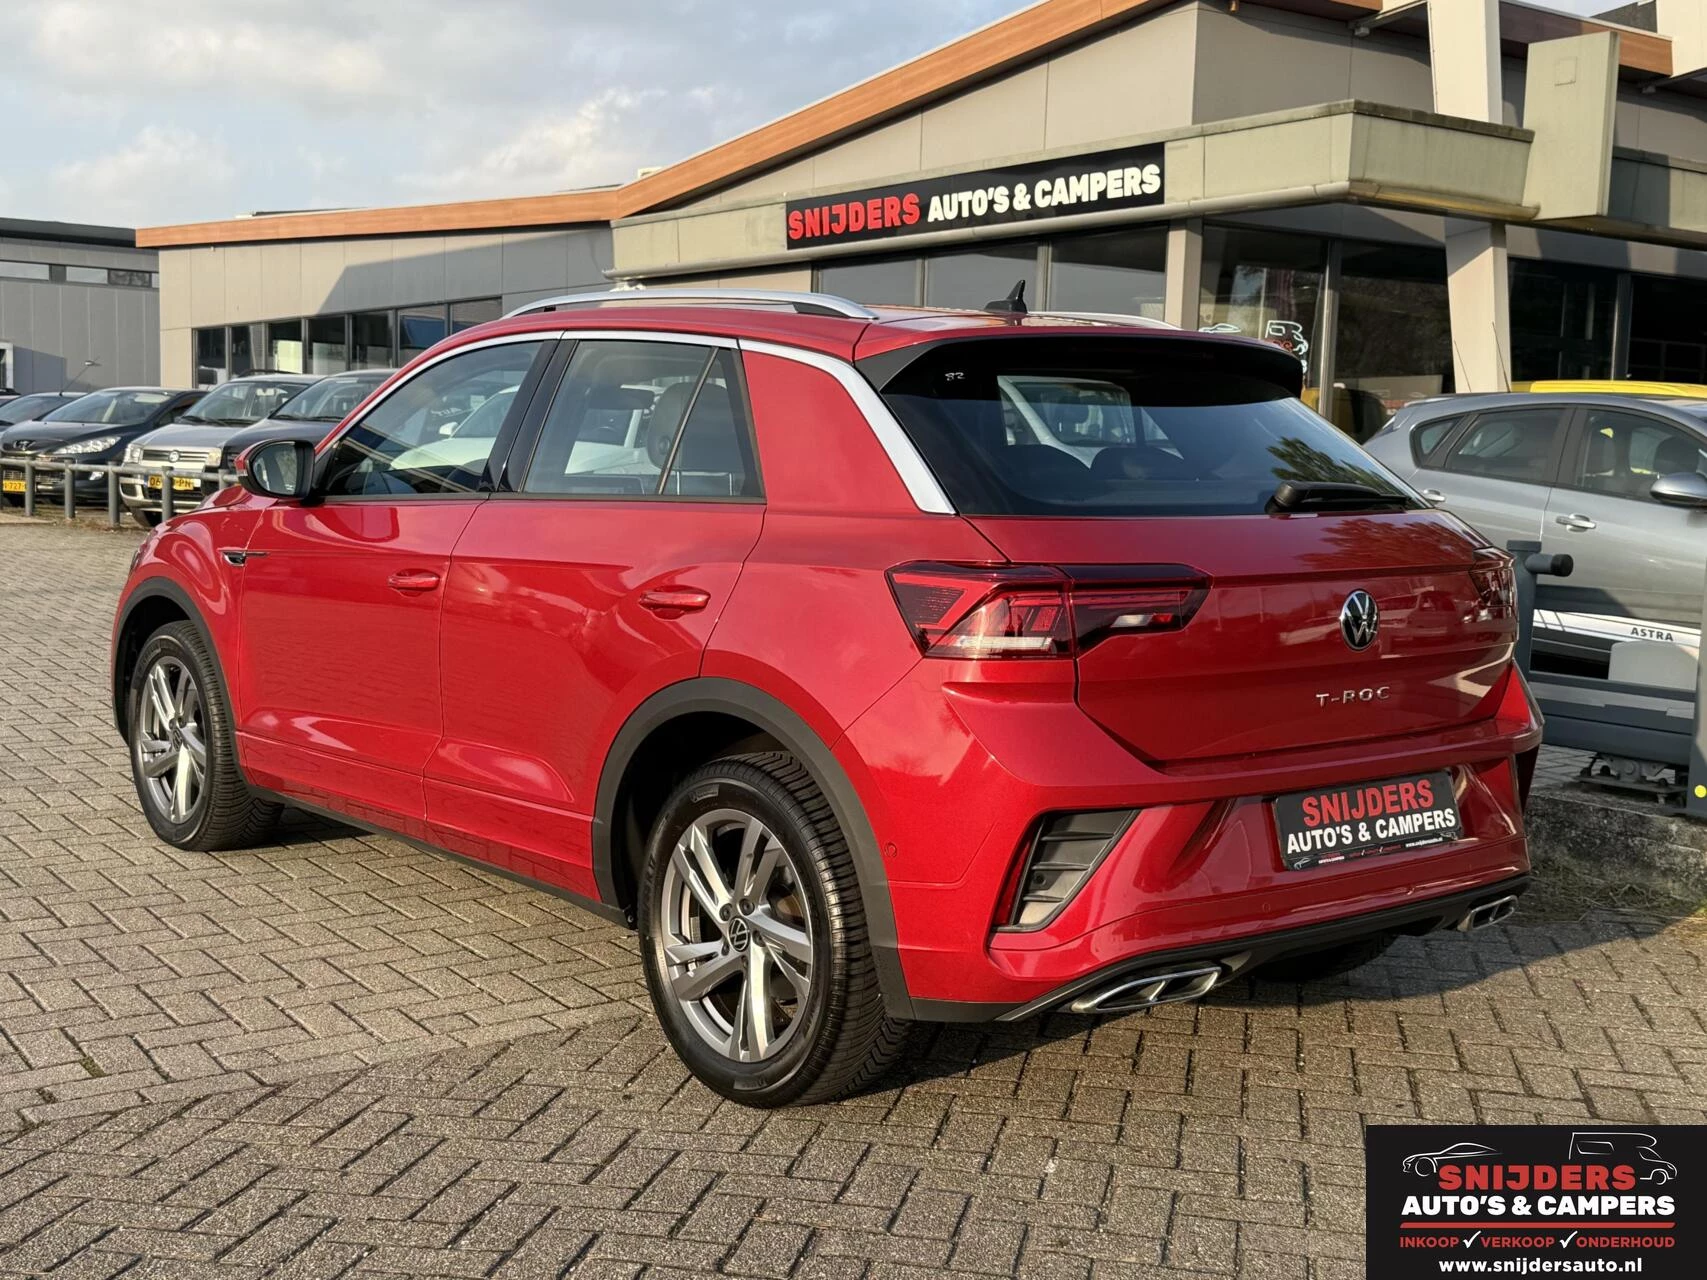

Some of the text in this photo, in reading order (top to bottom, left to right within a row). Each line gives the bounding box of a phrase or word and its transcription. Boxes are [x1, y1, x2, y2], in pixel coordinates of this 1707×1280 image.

[788, 164, 1161, 240] SNIJDERS AUTO'S & CAMPERS
[1631, 627, 1674, 641] ASTRA
[1315, 686, 1390, 708] T-ROC
[1302, 779, 1434, 827] SNIJDERS
[1287, 824, 1353, 854] AUTO'S
[1358, 822, 1371, 841] &
[1375, 808, 1456, 839] CAMPERS
